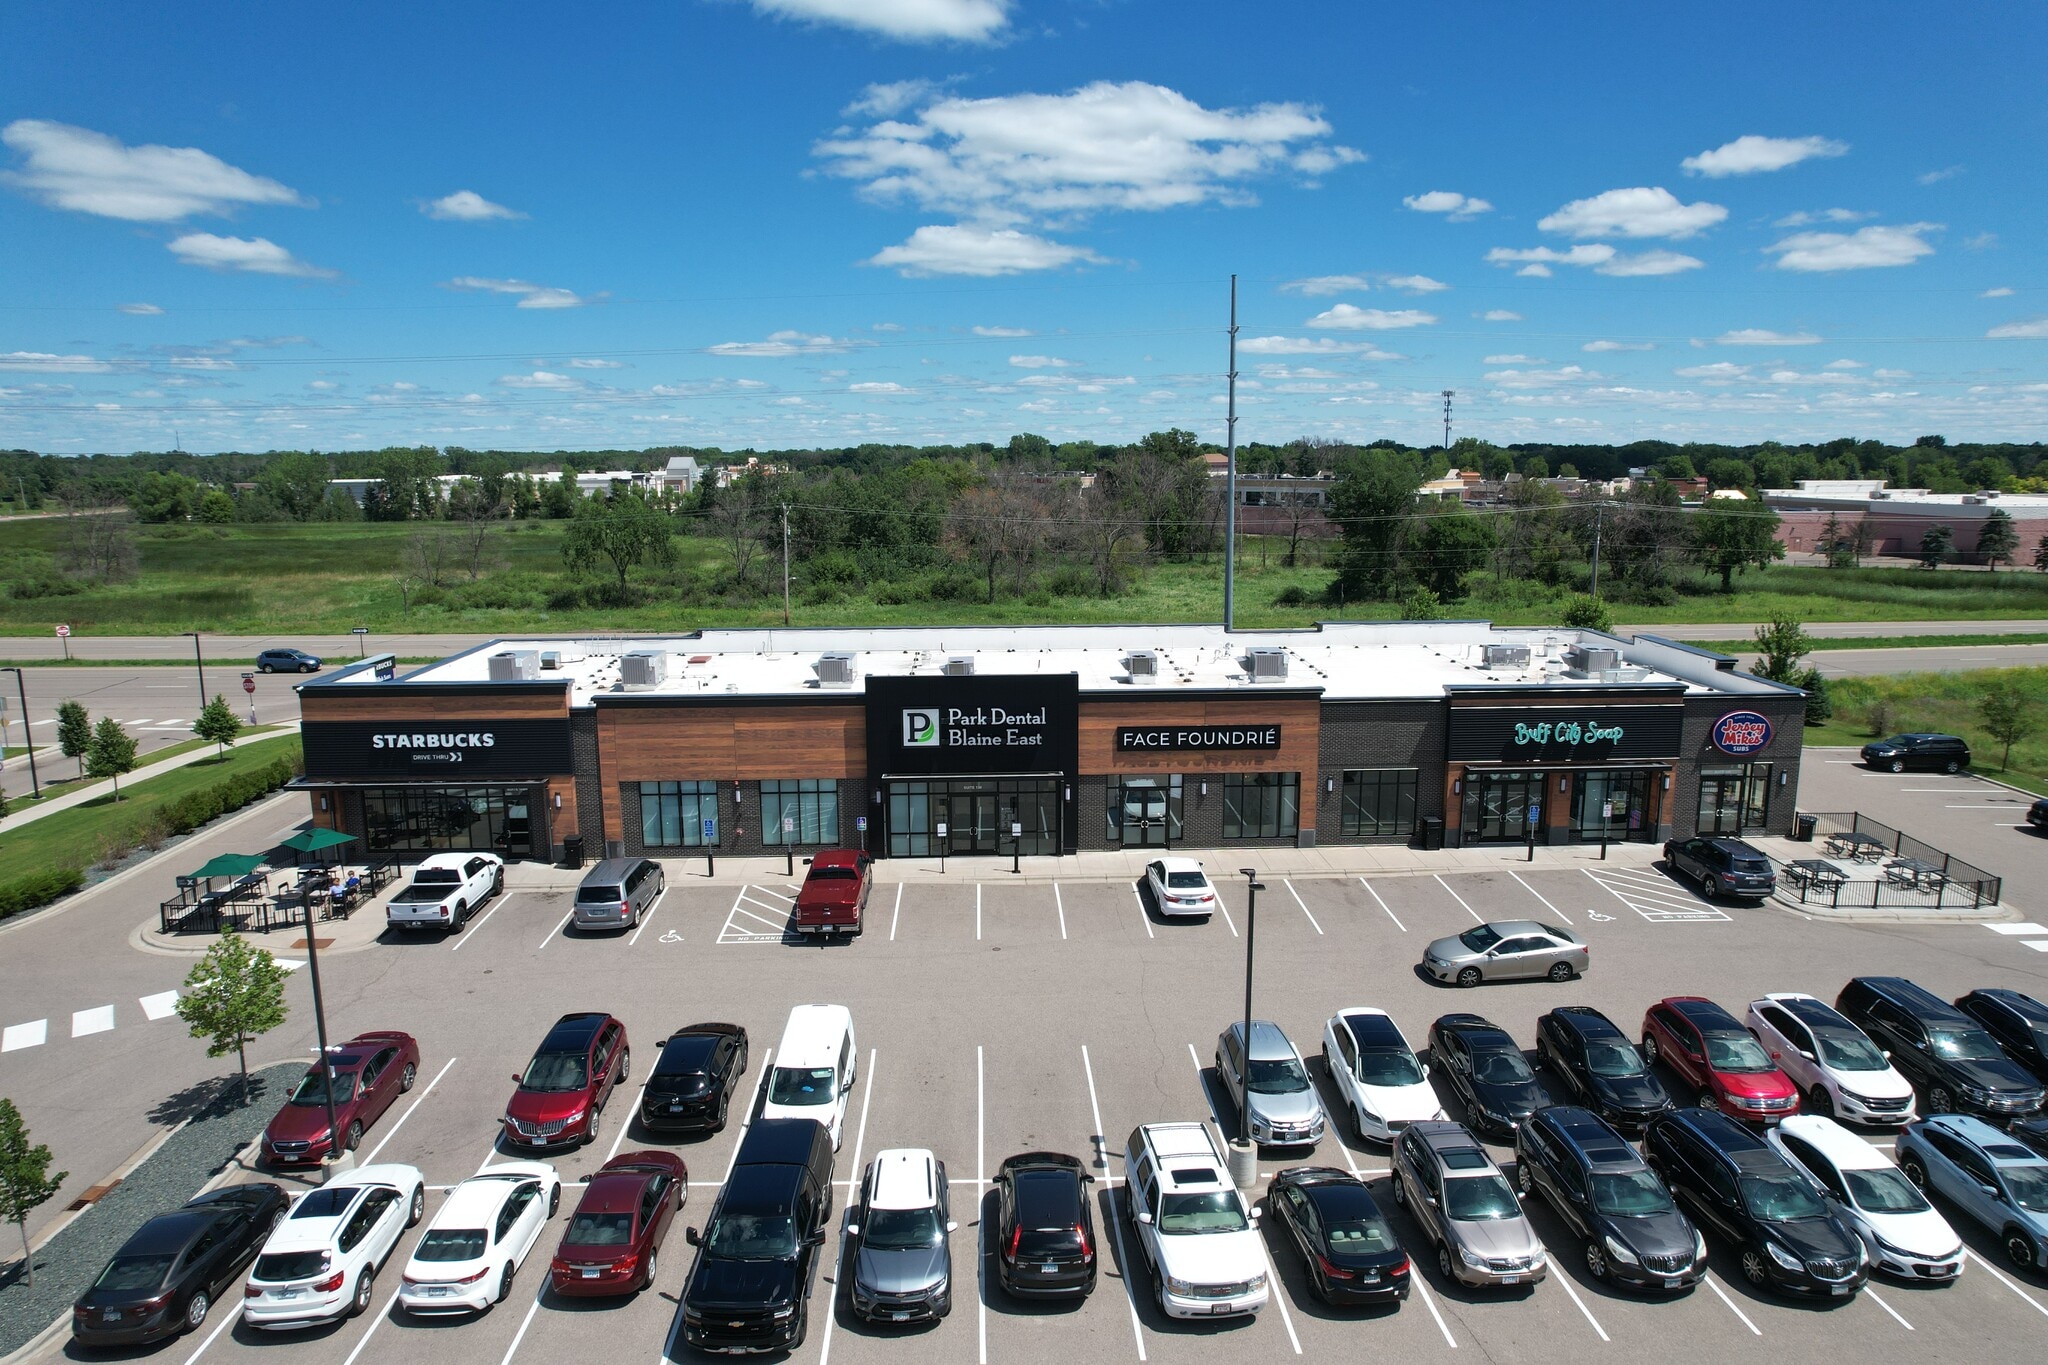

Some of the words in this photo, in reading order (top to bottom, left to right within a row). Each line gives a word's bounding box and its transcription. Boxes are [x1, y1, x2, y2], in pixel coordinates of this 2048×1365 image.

[948, 707, 987, 726] Park
[991, 707, 1046, 725] Dental
[1514, 722, 1553, 745] Buff
[1555, 721, 1581, 745] City
[1584, 721, 1624, 745] Soap
[1721, 719, 1766, 736] Jersey
[372, 733, 495, 748] STARBUCKS
[948, 729, 1002, 746] Blaine
[1006, 729, 1042, 746] East
[1123, 732, 1170, 746] FACE
[1177, 728, 1276, 746] FOUNDRIÉ
